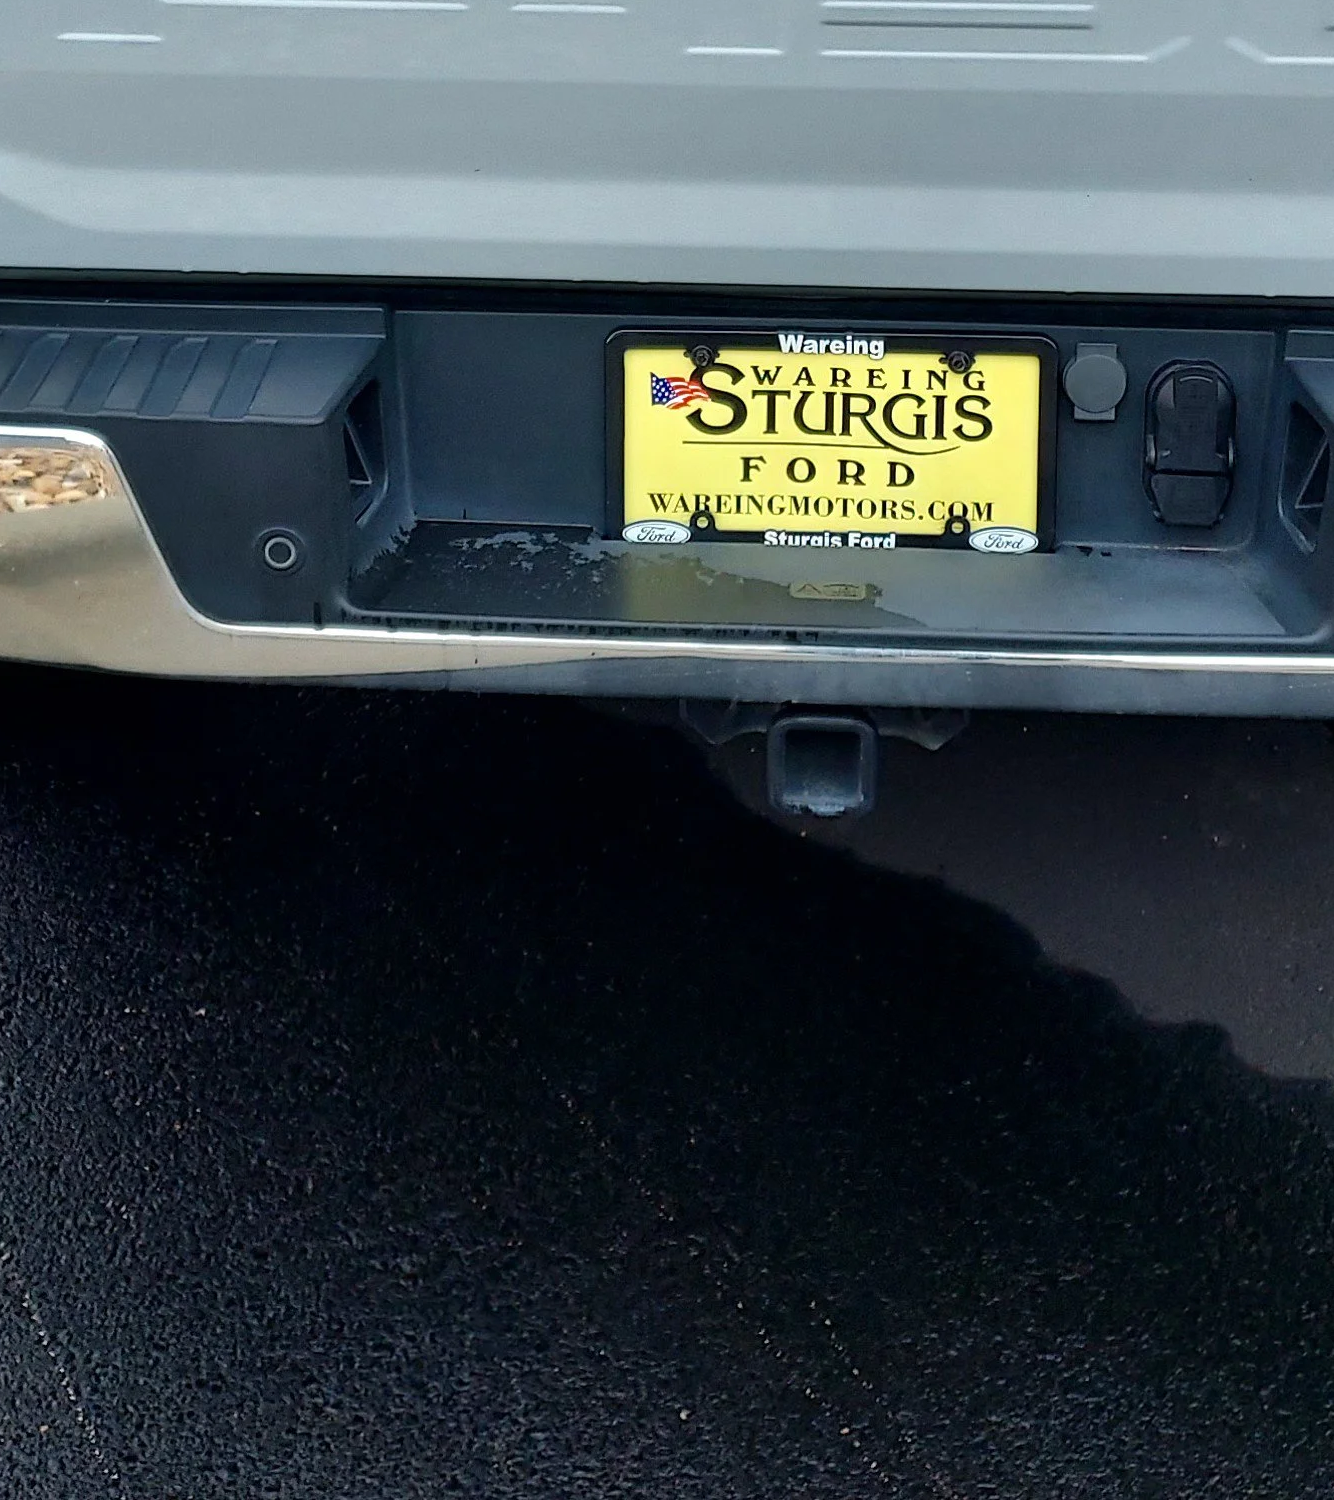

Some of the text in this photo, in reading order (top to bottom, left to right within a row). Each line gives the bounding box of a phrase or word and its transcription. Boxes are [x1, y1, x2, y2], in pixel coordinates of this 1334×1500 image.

[778, 333, 885, 360] Wareing
[751, 365, 986, 392] WAREING
[685, 362, 993, 448] STURGIS
[740, 455, 915, 488] FORD
[648, 492, 994, 523] WAREINGMOTORS.COM
[637, 526, 676, 543] Ford
[764, 530, 896, 549] Sturgis Ford
[984, 534, 1024, 550] Ford
